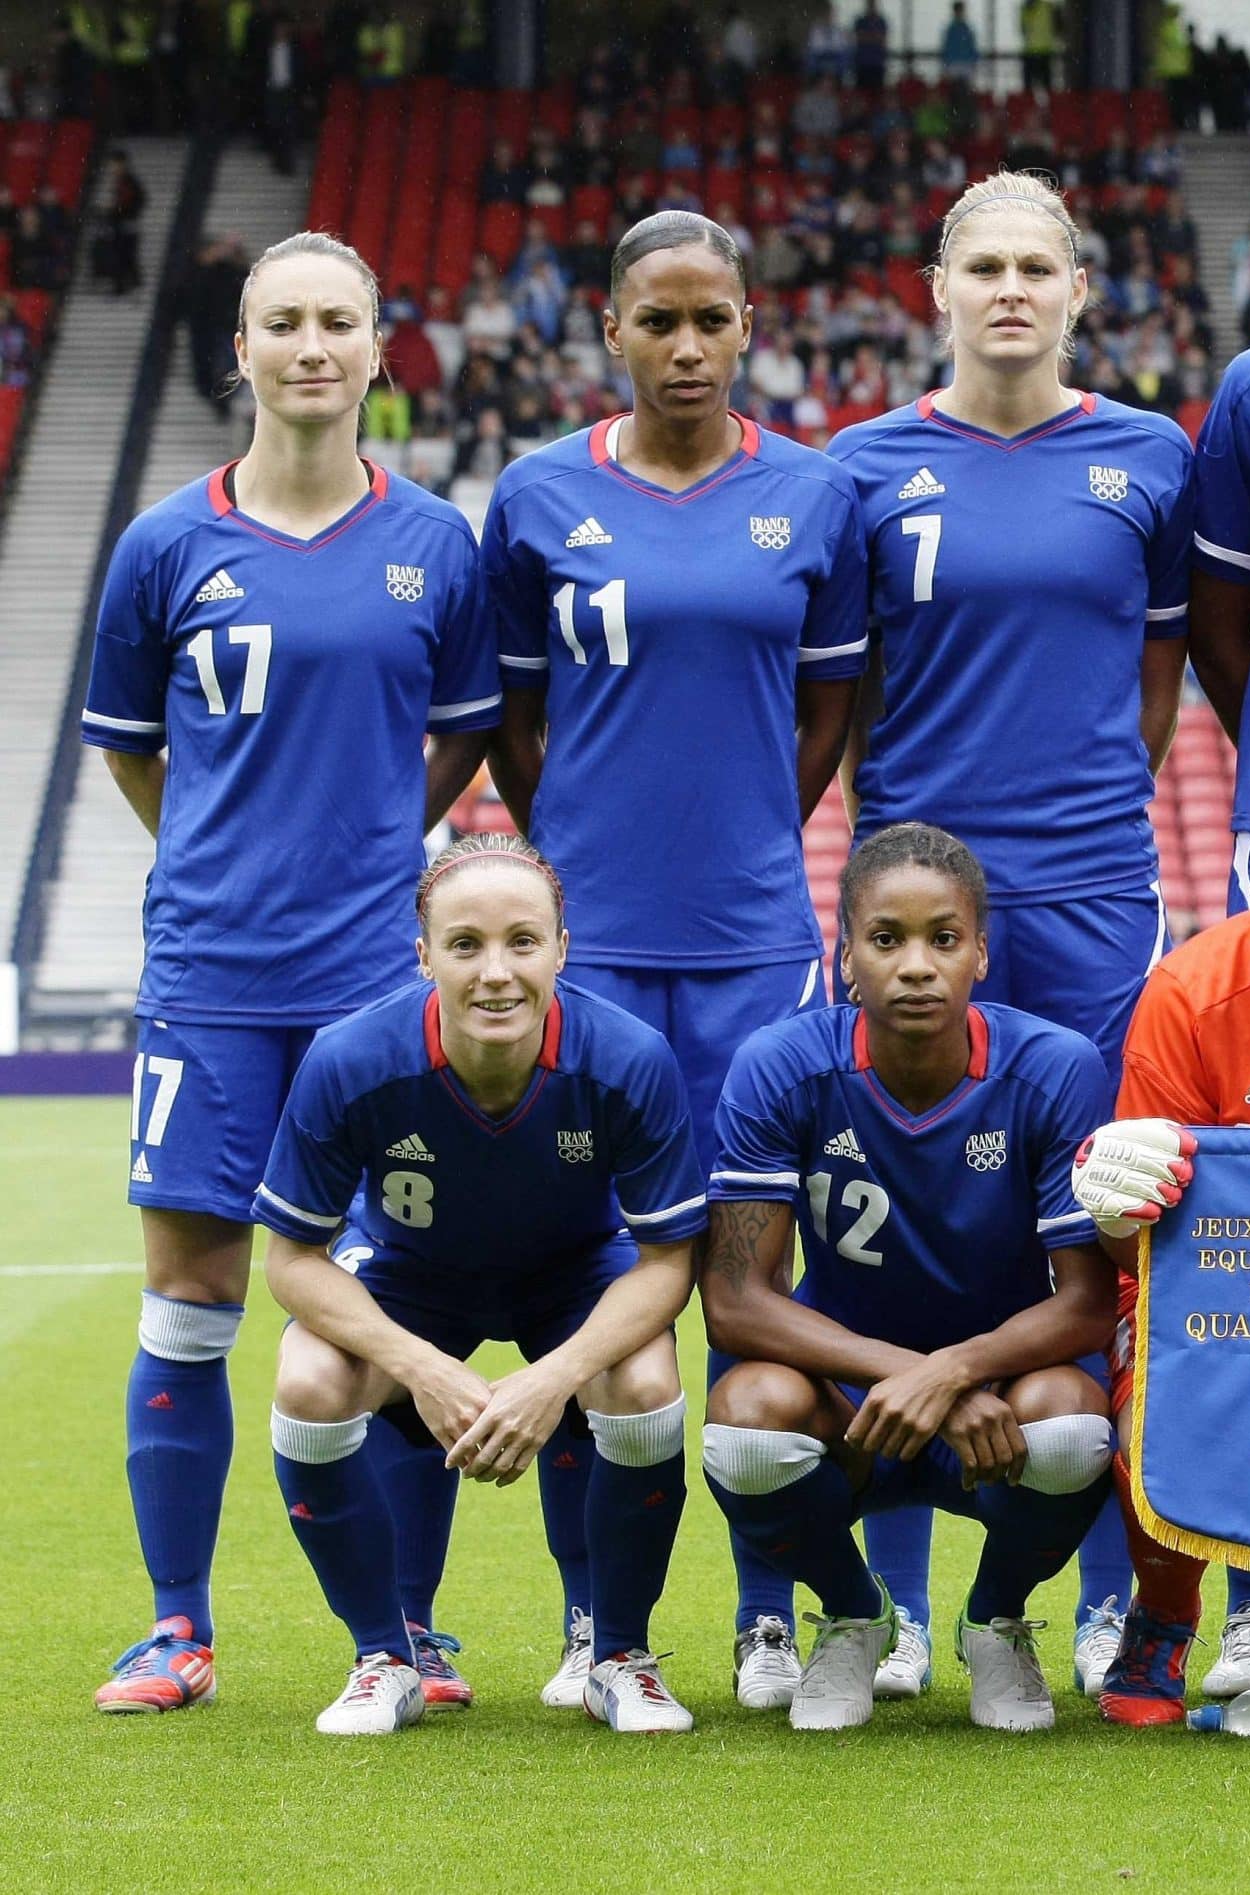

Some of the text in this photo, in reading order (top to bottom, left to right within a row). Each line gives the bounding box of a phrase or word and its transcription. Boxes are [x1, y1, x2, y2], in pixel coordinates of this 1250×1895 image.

[1089, 465, 1129, 485] FRANCE
[898, 482, 946, 500] adidas
[749, 516, 791, 533] FRANCE
[566, 533, 613, 548] adidas
[901, 514, 942, 602] 7
[386, 564, 424, 585] FRANCE
[196, 586, 244, 602] adidas
[552, 579, 629, 666] 11
[187, 624, 272, 715] 17
[131, 1052, 184, 1146] 17
[557, 1130, 593, 1145] FRANC
[385, 1148, 436, 1162] adidas
[823, 1143, 867, 1163] adidas
[382, 1171, 434, 1228] 8
[806, 1171, 890, 1267] 12
